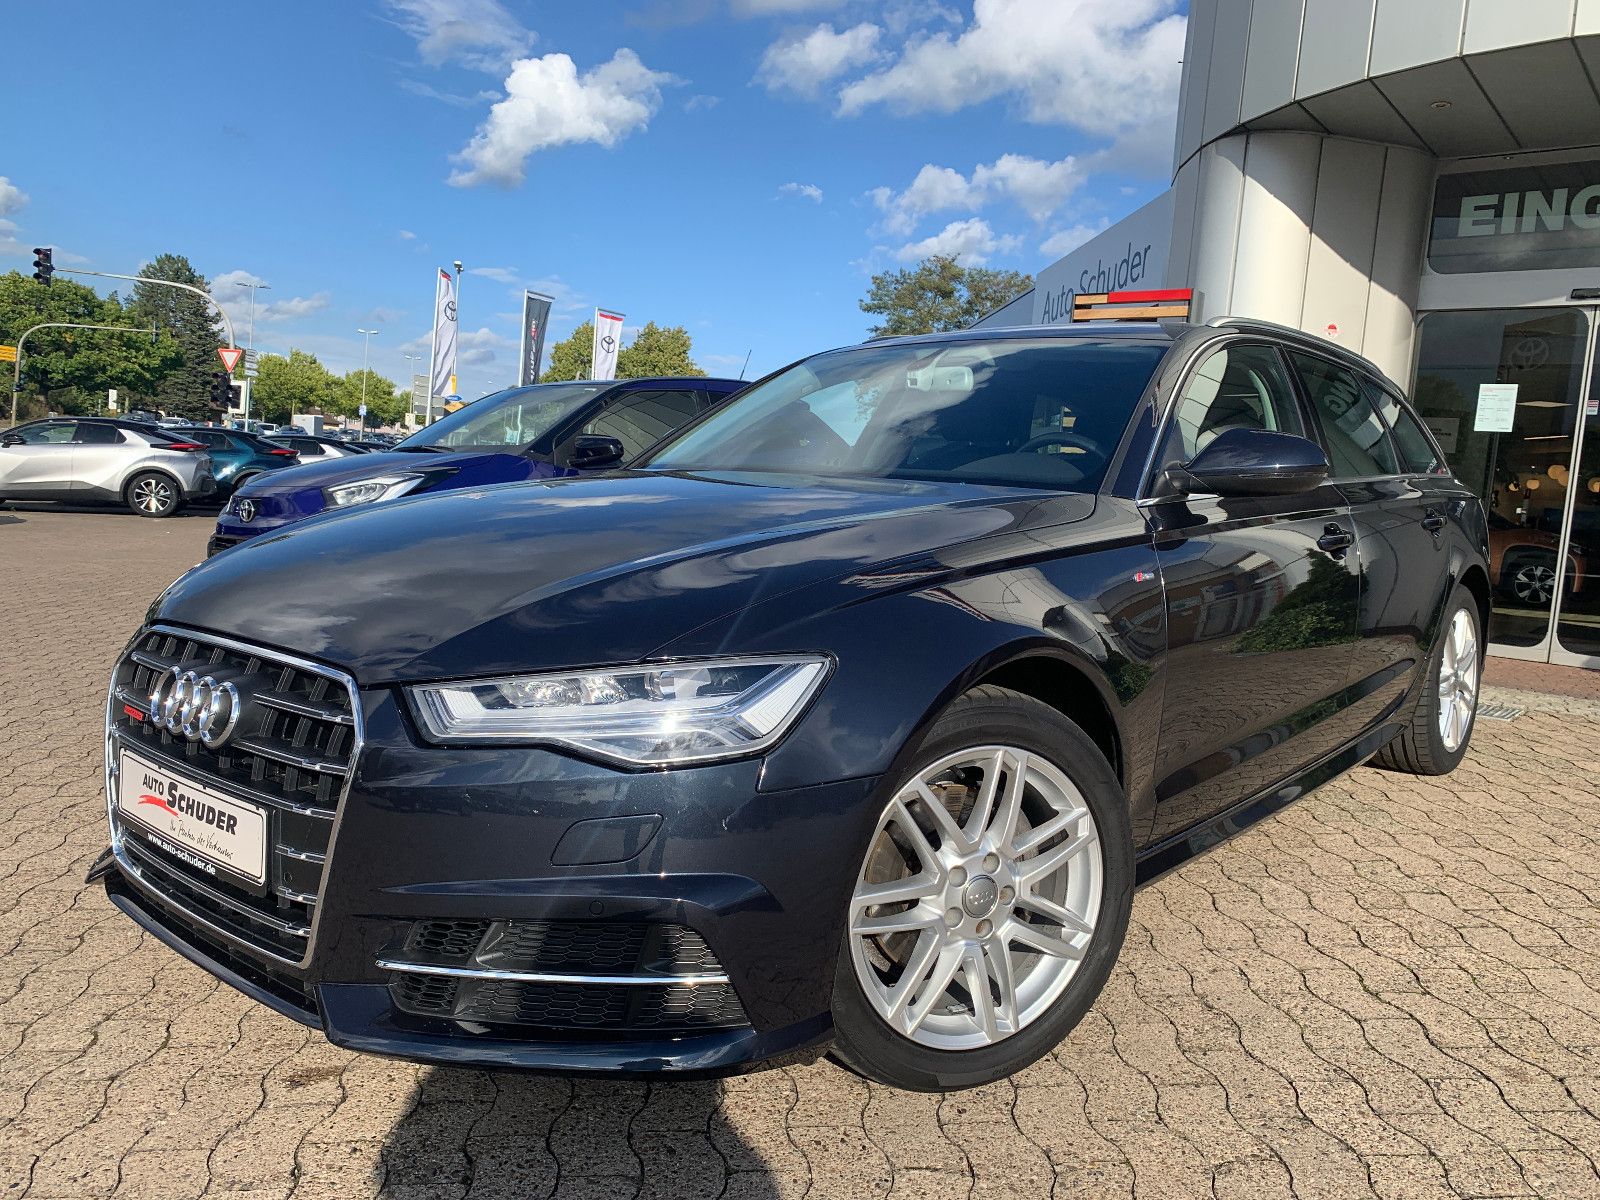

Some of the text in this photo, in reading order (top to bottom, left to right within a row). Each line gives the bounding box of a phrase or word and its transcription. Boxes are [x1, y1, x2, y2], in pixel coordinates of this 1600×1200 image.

[1042, 242, 1151, 325] Auto Schuder
[142, 773, 238, 835] AUTO SCHUDER
[147, 832, 216, 876] www.auto-schuder.de
